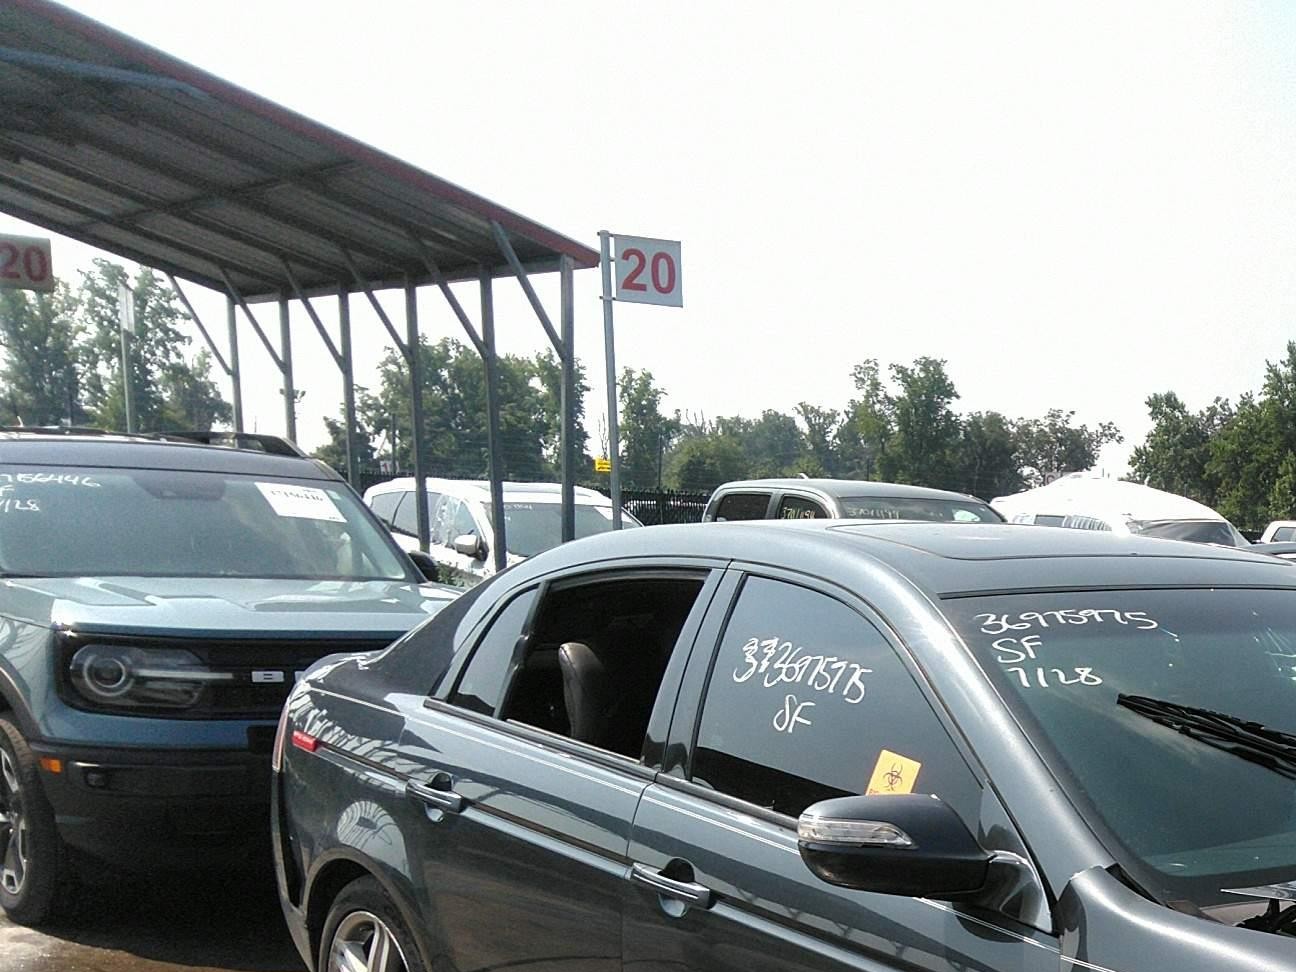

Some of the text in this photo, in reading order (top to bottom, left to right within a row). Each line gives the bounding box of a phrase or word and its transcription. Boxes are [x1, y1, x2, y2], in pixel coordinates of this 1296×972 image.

[0, 241, 48, 281] 20
[622, 248, 676, 294] 20
[991, 635, 1042, 664] SF
[773, 694, 816, 733] SF
